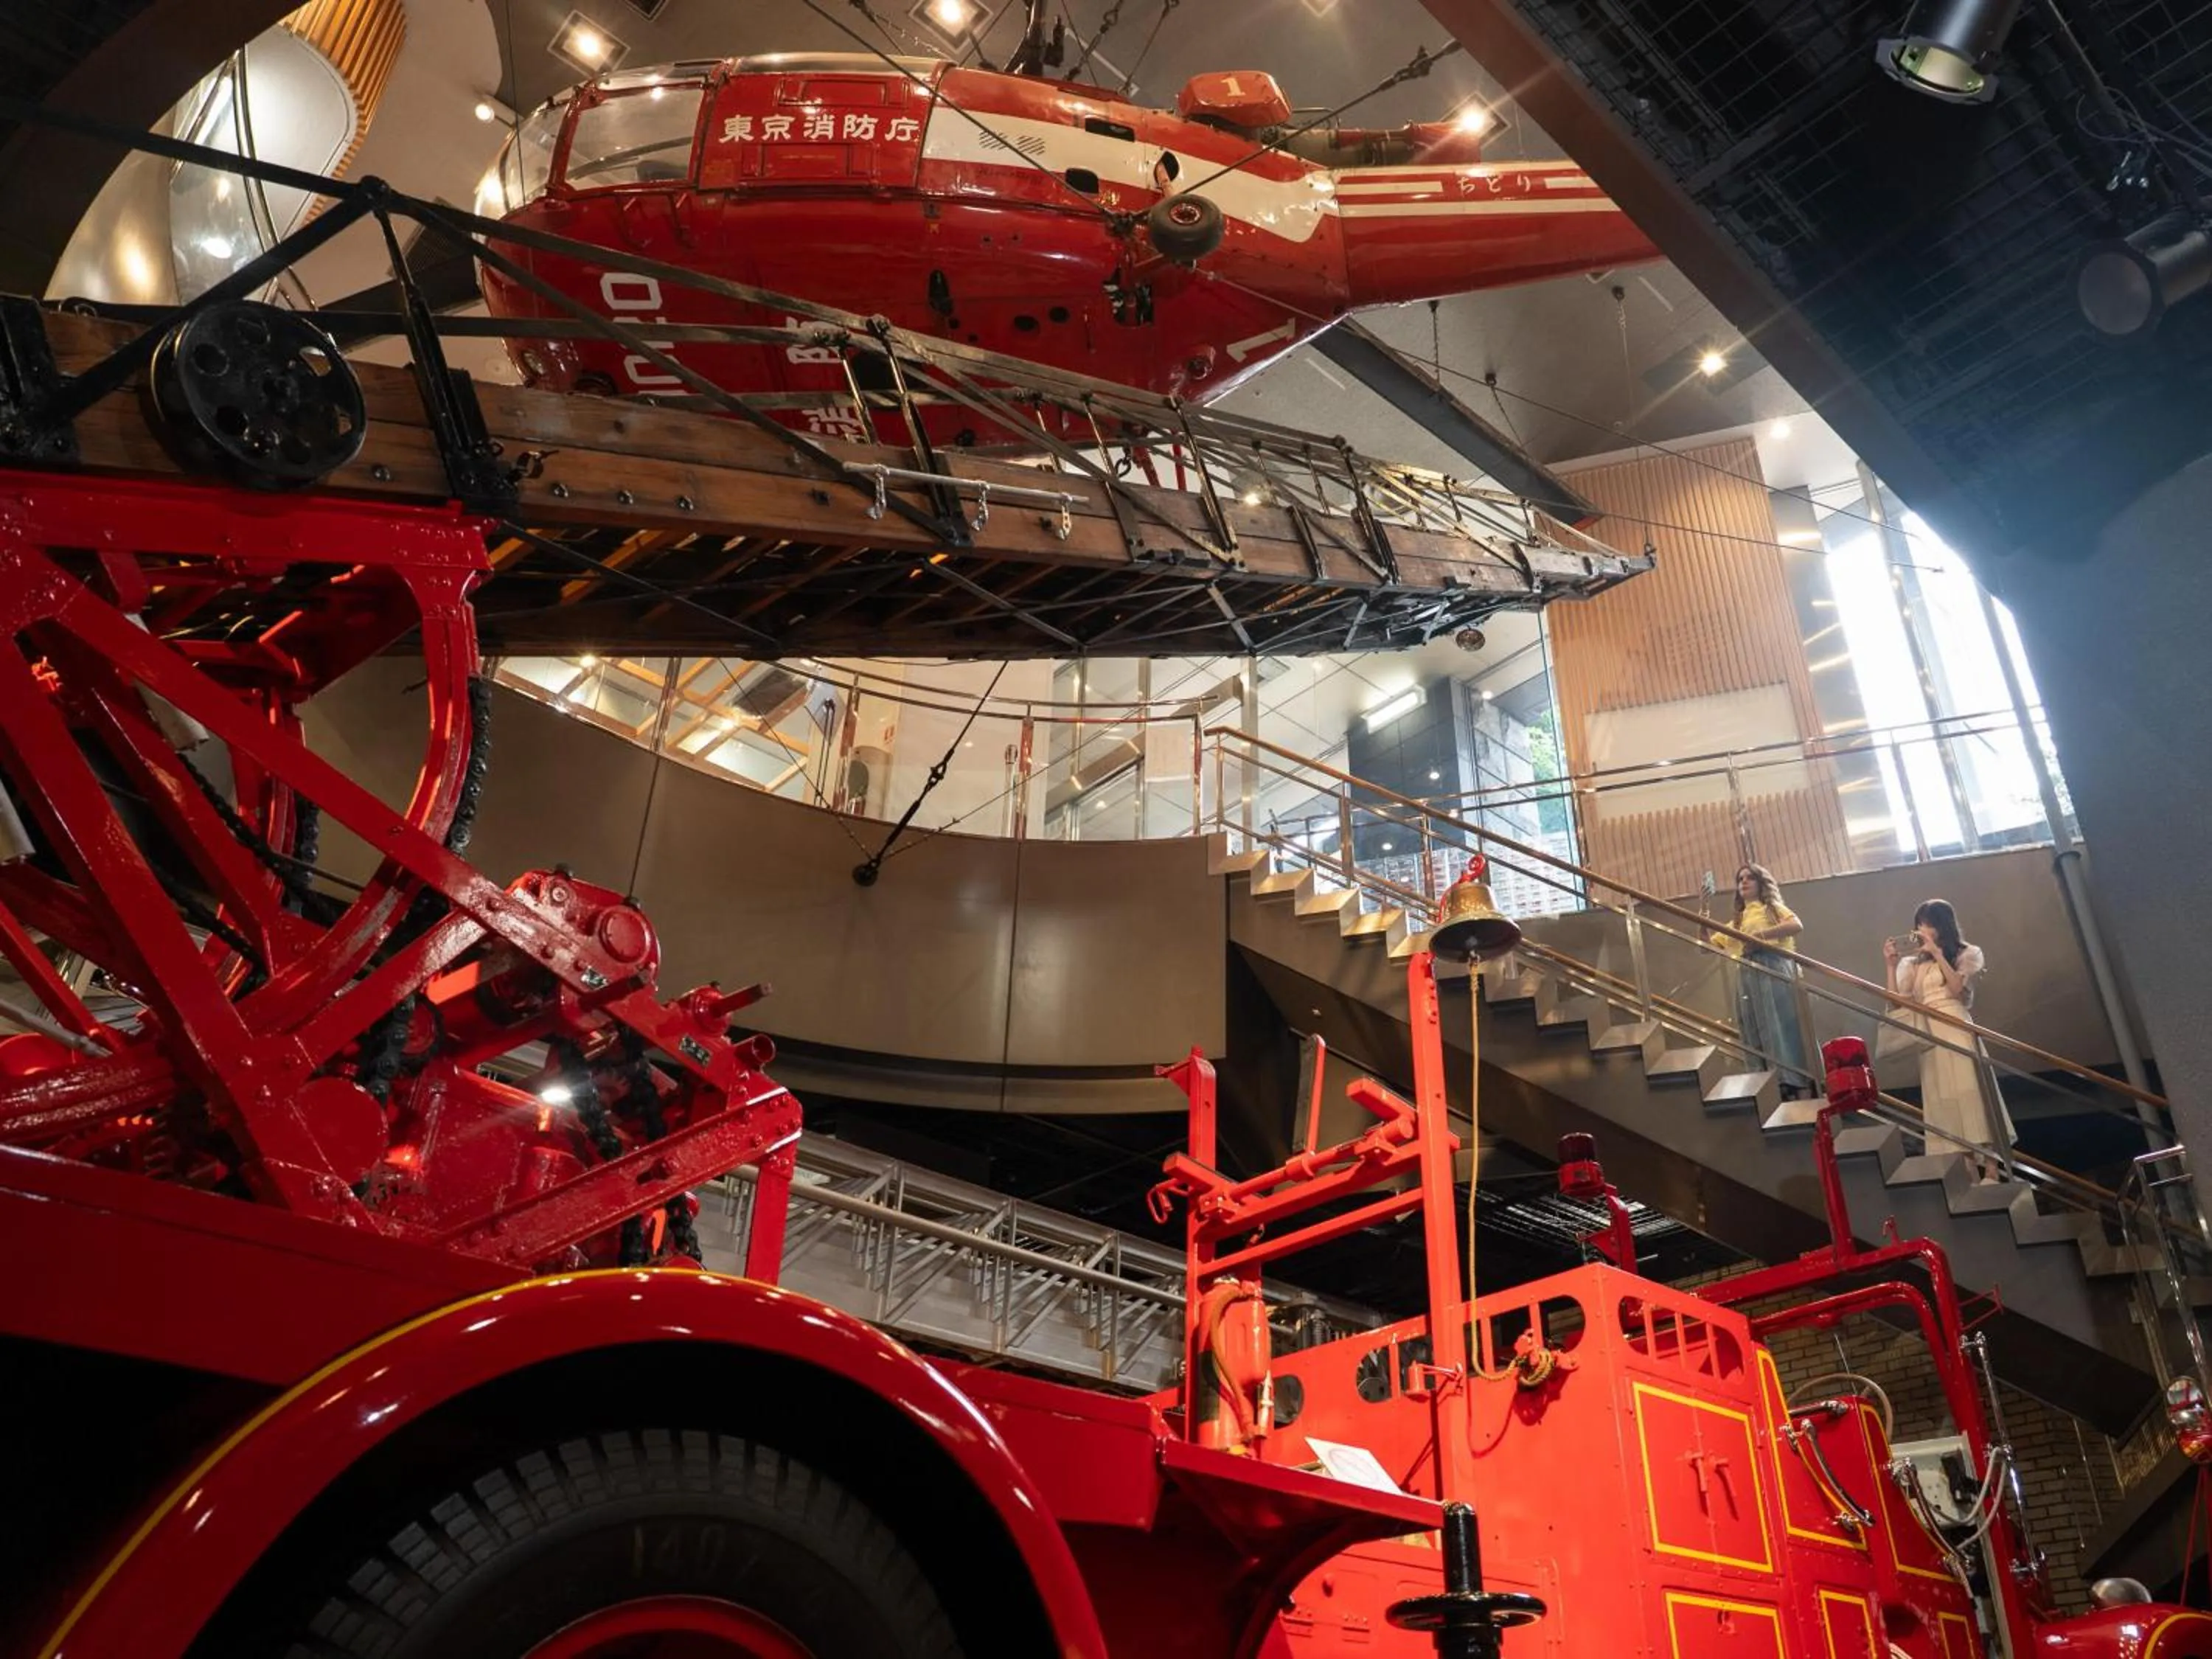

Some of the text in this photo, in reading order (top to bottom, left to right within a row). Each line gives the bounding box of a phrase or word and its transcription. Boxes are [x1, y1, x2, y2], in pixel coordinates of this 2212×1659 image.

[1220, 77, 1246, 97] 1
[719, 114, 920, 143] 東京消防庁
[1457, 173, 1531, 198] ちどり
[1227, 318, 1295, 363] 1
